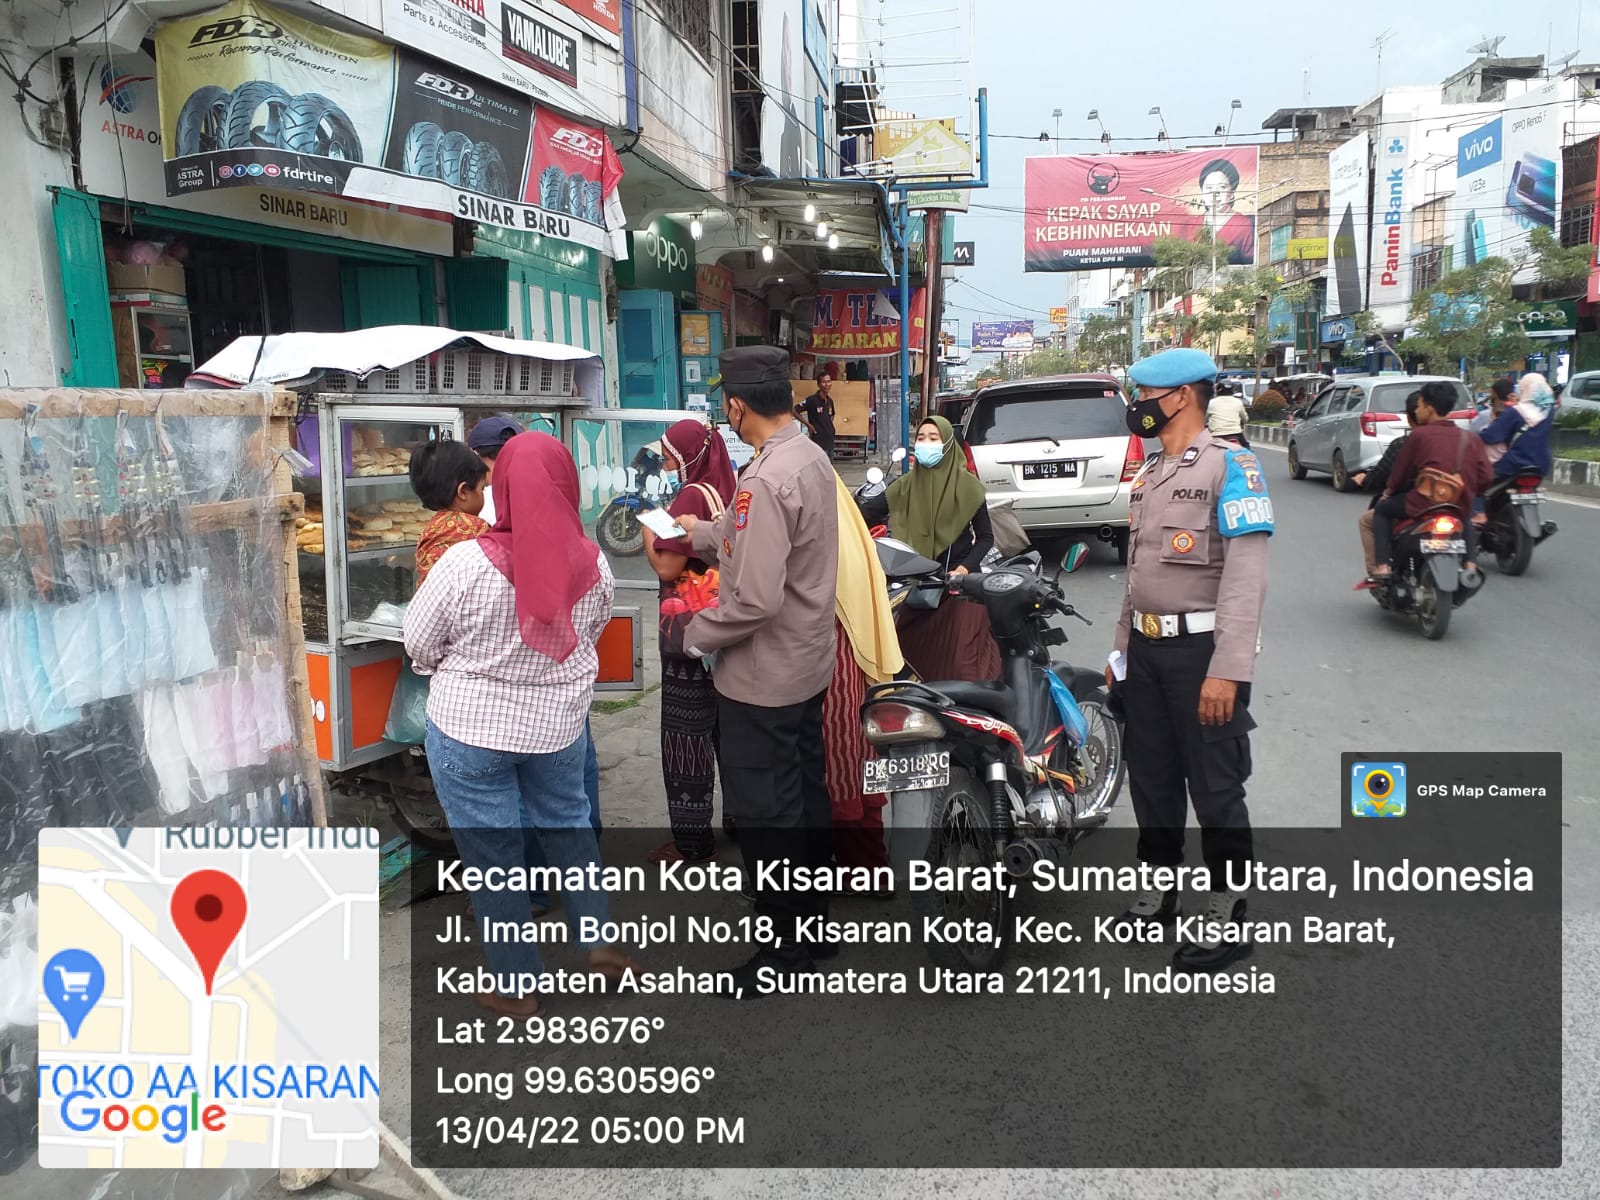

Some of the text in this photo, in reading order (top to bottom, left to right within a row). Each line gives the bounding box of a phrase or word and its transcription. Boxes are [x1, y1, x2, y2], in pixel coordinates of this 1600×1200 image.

[188, 16, 284, 47] FDR
[403, 2, 428, 23] Parts
[429, 15, 436, 26] &
[437, 19, 487, 50] Accessories
[284, 35, 360, 65] CHAMPION
[507, 10, 570, 71] YAMALUBE
[219, 43, 338, 75] Racing Performance
[413, 72, 475, 101] FDR
[474, 94, 520, 116] ULTIMATE
[101, 120, 145, 141] ASTRA
[550, 127, 604, 157] FDR
[1465, 135, 1494, 161] vivo
[177, 168, 205, 180] ASTRA
[178, 178, 204, 188] Group
[282, 167, 334, 185] fdrtire
[259, 194, 348, 226] SINAR BARU
[458, 194, 571, 238] SINAR BARU
[1047, 202, 1161, 223] KEPAK SAYAP
[1035, 220, 1172, 242] KEBHINNEKAAN
[1380, 167, 1404, 286] PaninBank
[646, 232, 688, 273] oppo
[1063, 245, 1142, 257] PUAN MAHARANI
[1080, 256, 1101, 264] KETUA
[1328, 320, 1344, 337] vivo
[812, 331, 898, 349] KISARAN
[1024, 462, 1076, 475] BK 1215 NA
[1172, 488, 1209, 501] POLRI
[888, 756, 925, 774] 6318
